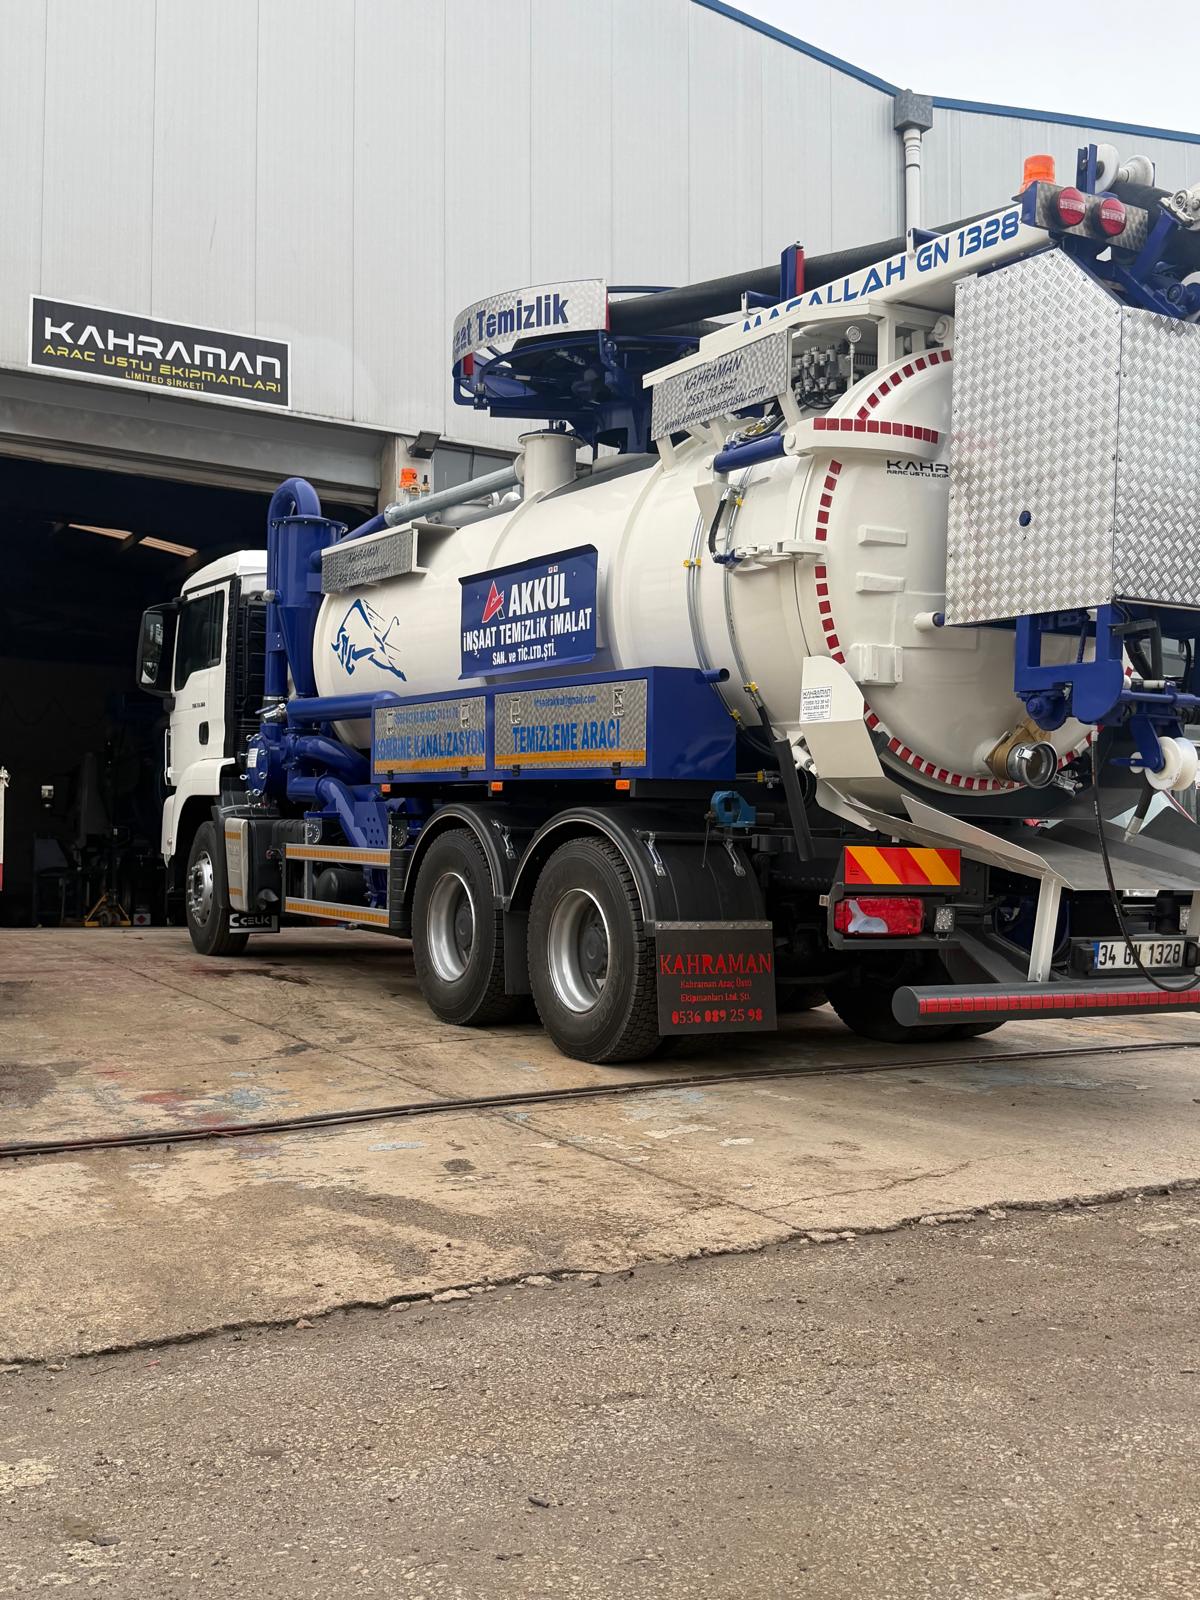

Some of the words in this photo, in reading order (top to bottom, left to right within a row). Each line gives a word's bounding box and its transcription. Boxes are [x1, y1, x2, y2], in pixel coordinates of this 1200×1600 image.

[916, 237, 950, 272] GN
[957, 210, 1020, 257] 1328
[476, 293, 569, 341] Temizlik
[44, 317, 281, 379] KAHRAMAN
[159, 364, 281, 393] EKIPMANLARI
[684, 355, 743, 391] KAHRAMAN
[508, 566, 570, 618] AKKÜL
[492, 650, 507, 666] SAN.
[508, 652, 517, 663] ve
[581, 719, 621, 750] ARACI
[660, 952, 772, 975] KAHRAMAN
[1099, 944, 1116, 966] 34
[1149, 943, 1181, 965] 1328
[680, 979, 717, 989] Kahraman
[671, 1010, 702, 1025] 0536
[704, 1009, 727, 1023] 089
[730, 1008, 745, 1022] 25
[748, 1007, 763, 1022] 98
